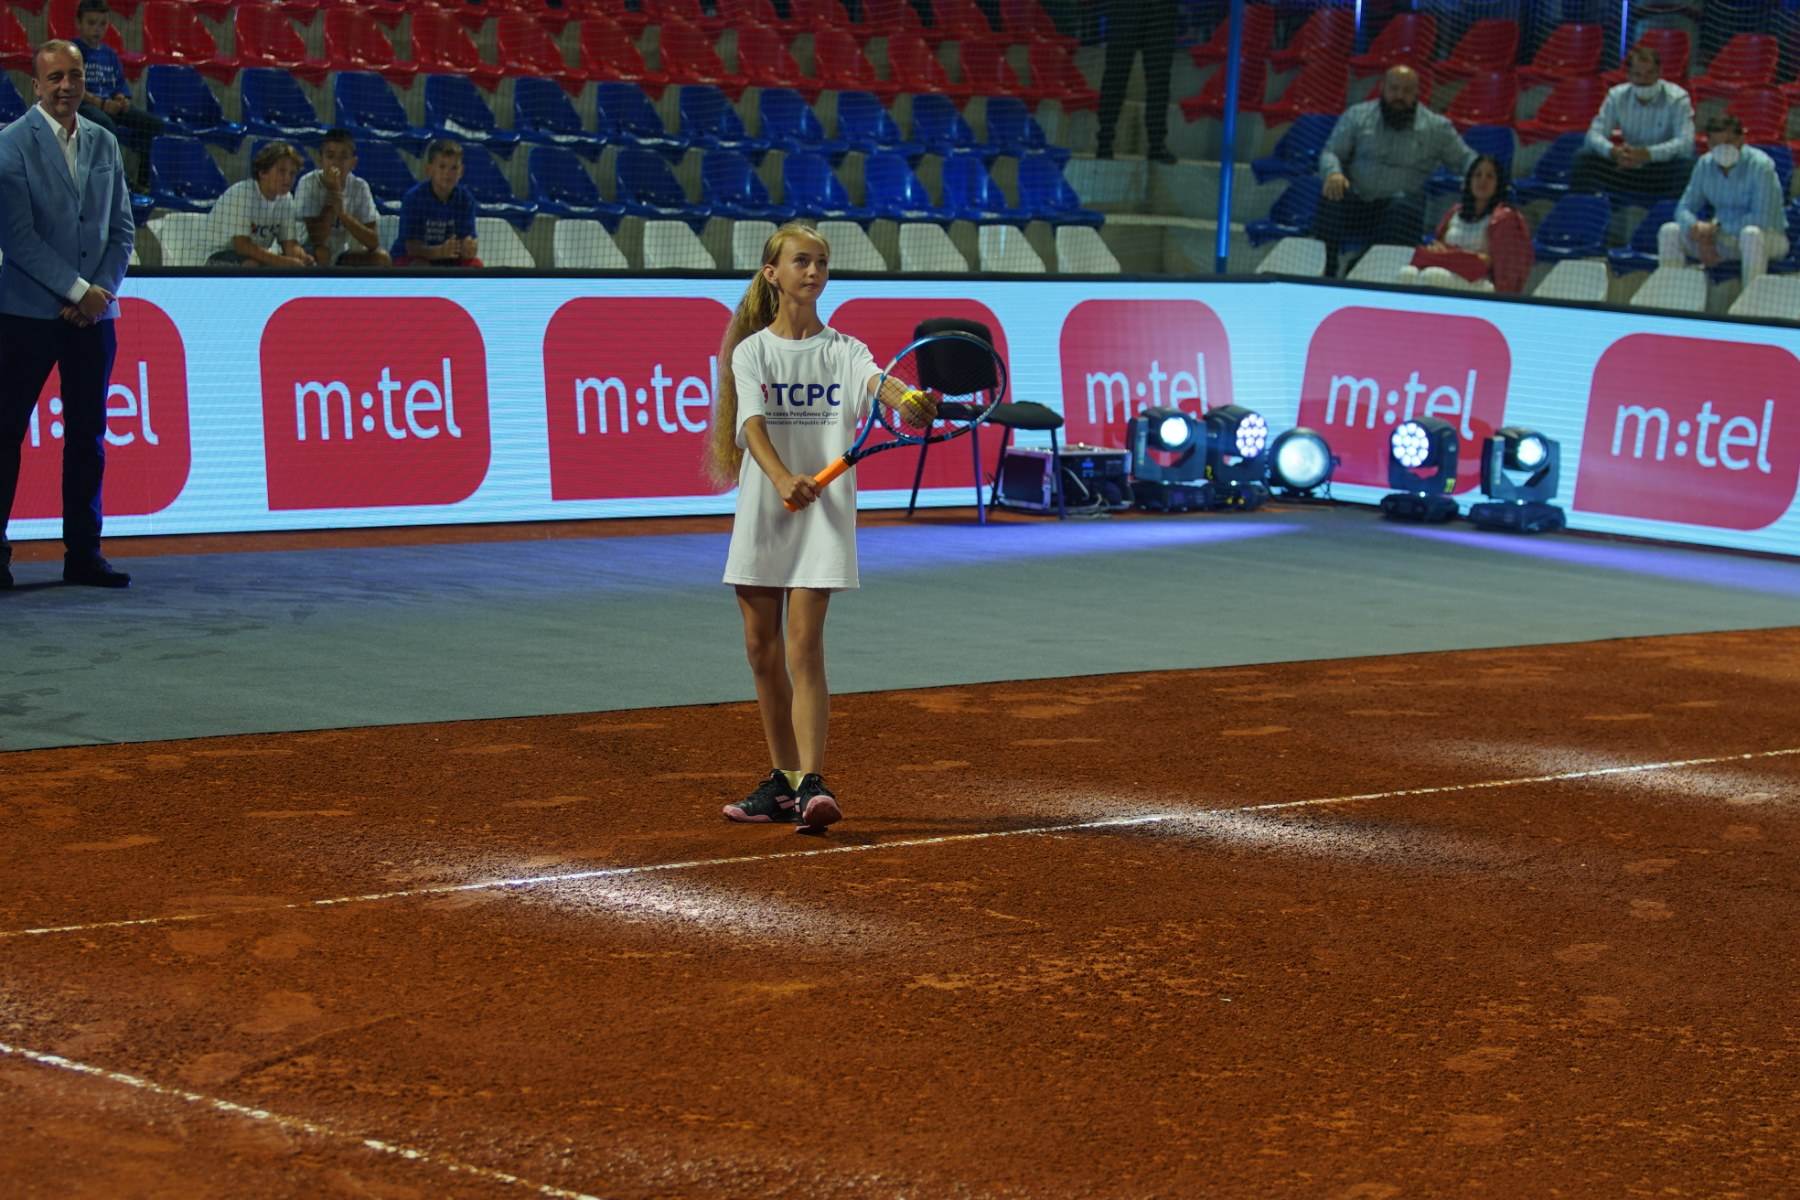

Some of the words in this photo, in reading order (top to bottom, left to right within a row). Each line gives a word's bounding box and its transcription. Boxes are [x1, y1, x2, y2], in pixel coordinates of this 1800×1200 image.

[294, 357, 462, 441] m:tel
[575, 355, 719, 434] m:tel
[1086, 352, 1208, 424] m:tel
[1325, 369, 1477, 441] m:tel
[1611, 399, 1774, 474] m:tel
